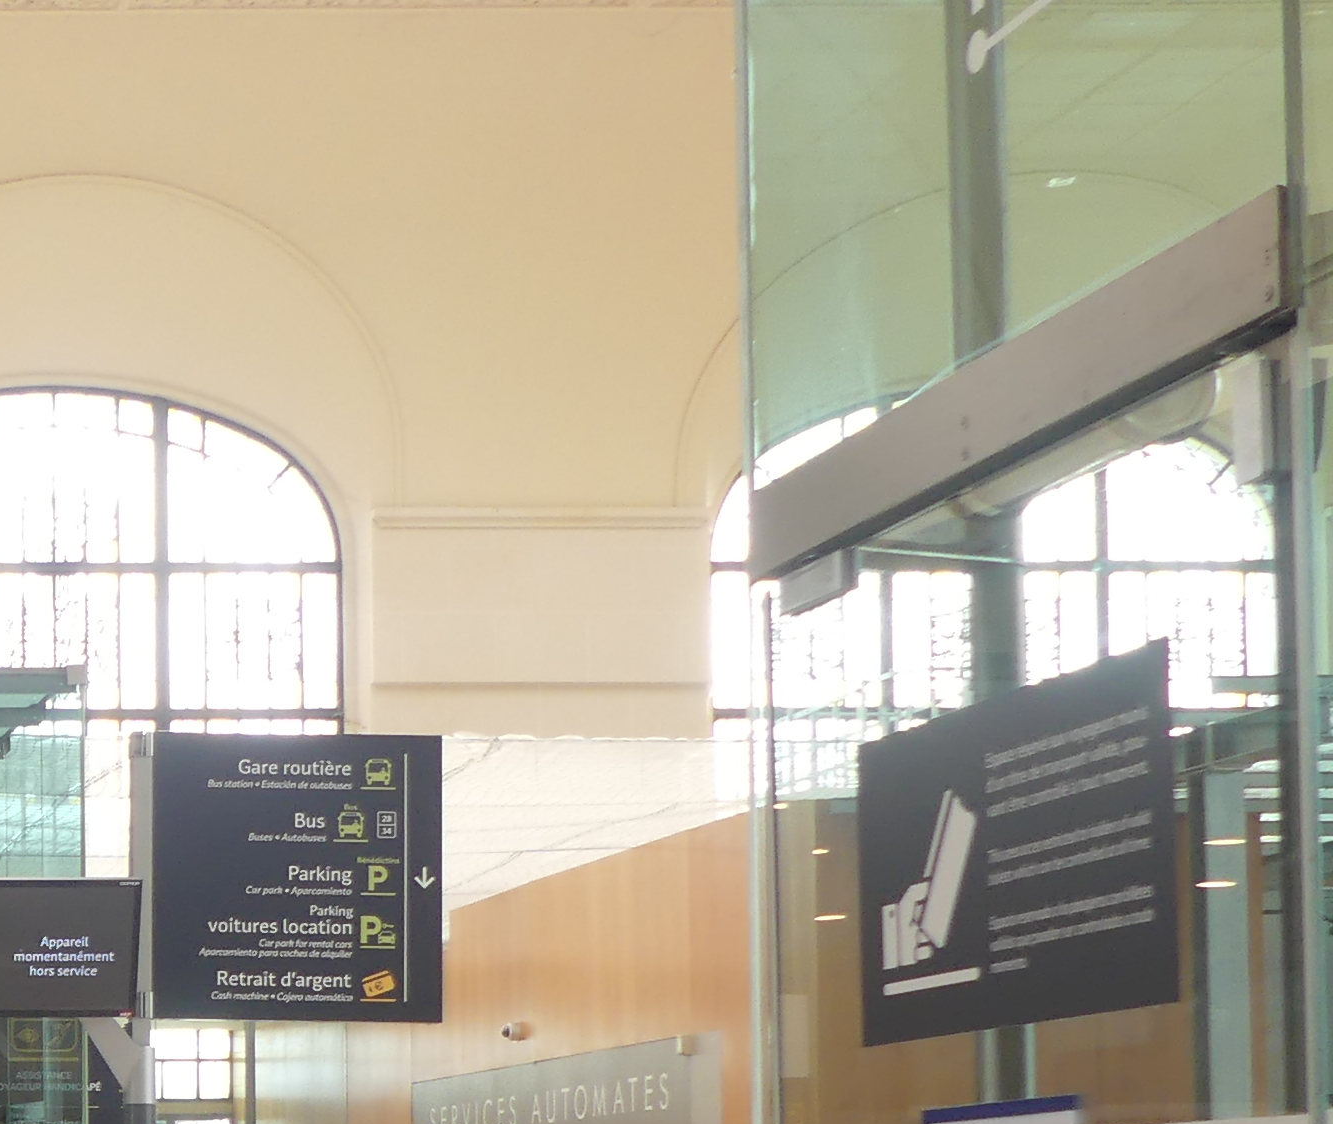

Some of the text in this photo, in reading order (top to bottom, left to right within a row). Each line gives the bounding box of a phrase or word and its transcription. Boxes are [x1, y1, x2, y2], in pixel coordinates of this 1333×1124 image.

[238, 759, 352, 776] Gare routière
[207, 779, 353, 790] Bus station Estación de autobuses
[295, 813, 326, 828] Bus
[248, 833, 327, 843] Buses Autobuses
[288, 866, 353, 885] Parking
[245, 885, 353, 897] Car park Aparcamiento
[309, 905, 354, 918] Parking
[207, 918, 353, 935] voitures location
[40, 936, 89, 949] Appareil
[259, 938, 274, 948] Car
[275, 939, 294, 949] park
[13, 950, 115, 961] momentanément
[29, 965, 98, 976] hors service
[216, 970, 352, 991] Retrait d'argent
[210, 991, 232, 1000] Cash
[233, 991, 269, 1000] machine
[531, 1072, 671, 1124] AUTOMATES
